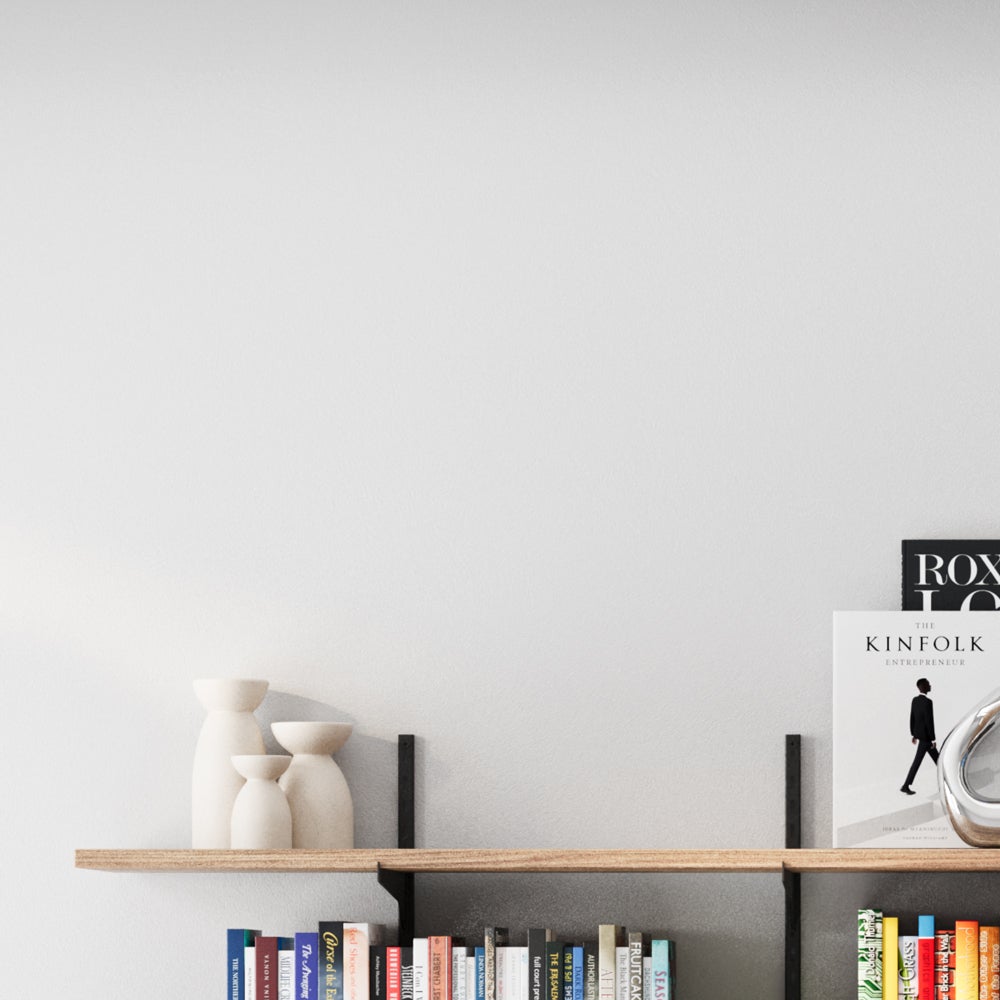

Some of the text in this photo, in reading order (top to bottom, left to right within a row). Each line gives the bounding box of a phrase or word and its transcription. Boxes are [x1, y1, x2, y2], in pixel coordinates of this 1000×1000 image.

[866, 636, 984, 652] KINFOLK
[302, 944, 311, 958] The
[323, 932, 338, 962] Curse
[551, 952, 559, 966] THE
[280, 956, 291, 988] MIDLIFE
[326, 964, 336, 973] of
[349, 948, 357, 975] Shoes
[433, 953, 441, 985] CHABERT
[864, 946, 876, 976] Donald
[900, 942, 916, 981] GRASS
[980, 955, 988, 982] Other
[326, 976, 336, 987] the
[401, 965, 413, 1000] STEINBECK
[550, 968, 559, 1000] JERUSALEM
[940, 974, 949, 992] Brick
[980, 986, 988, 1000] the
[992, 975, 1000, 990] the
